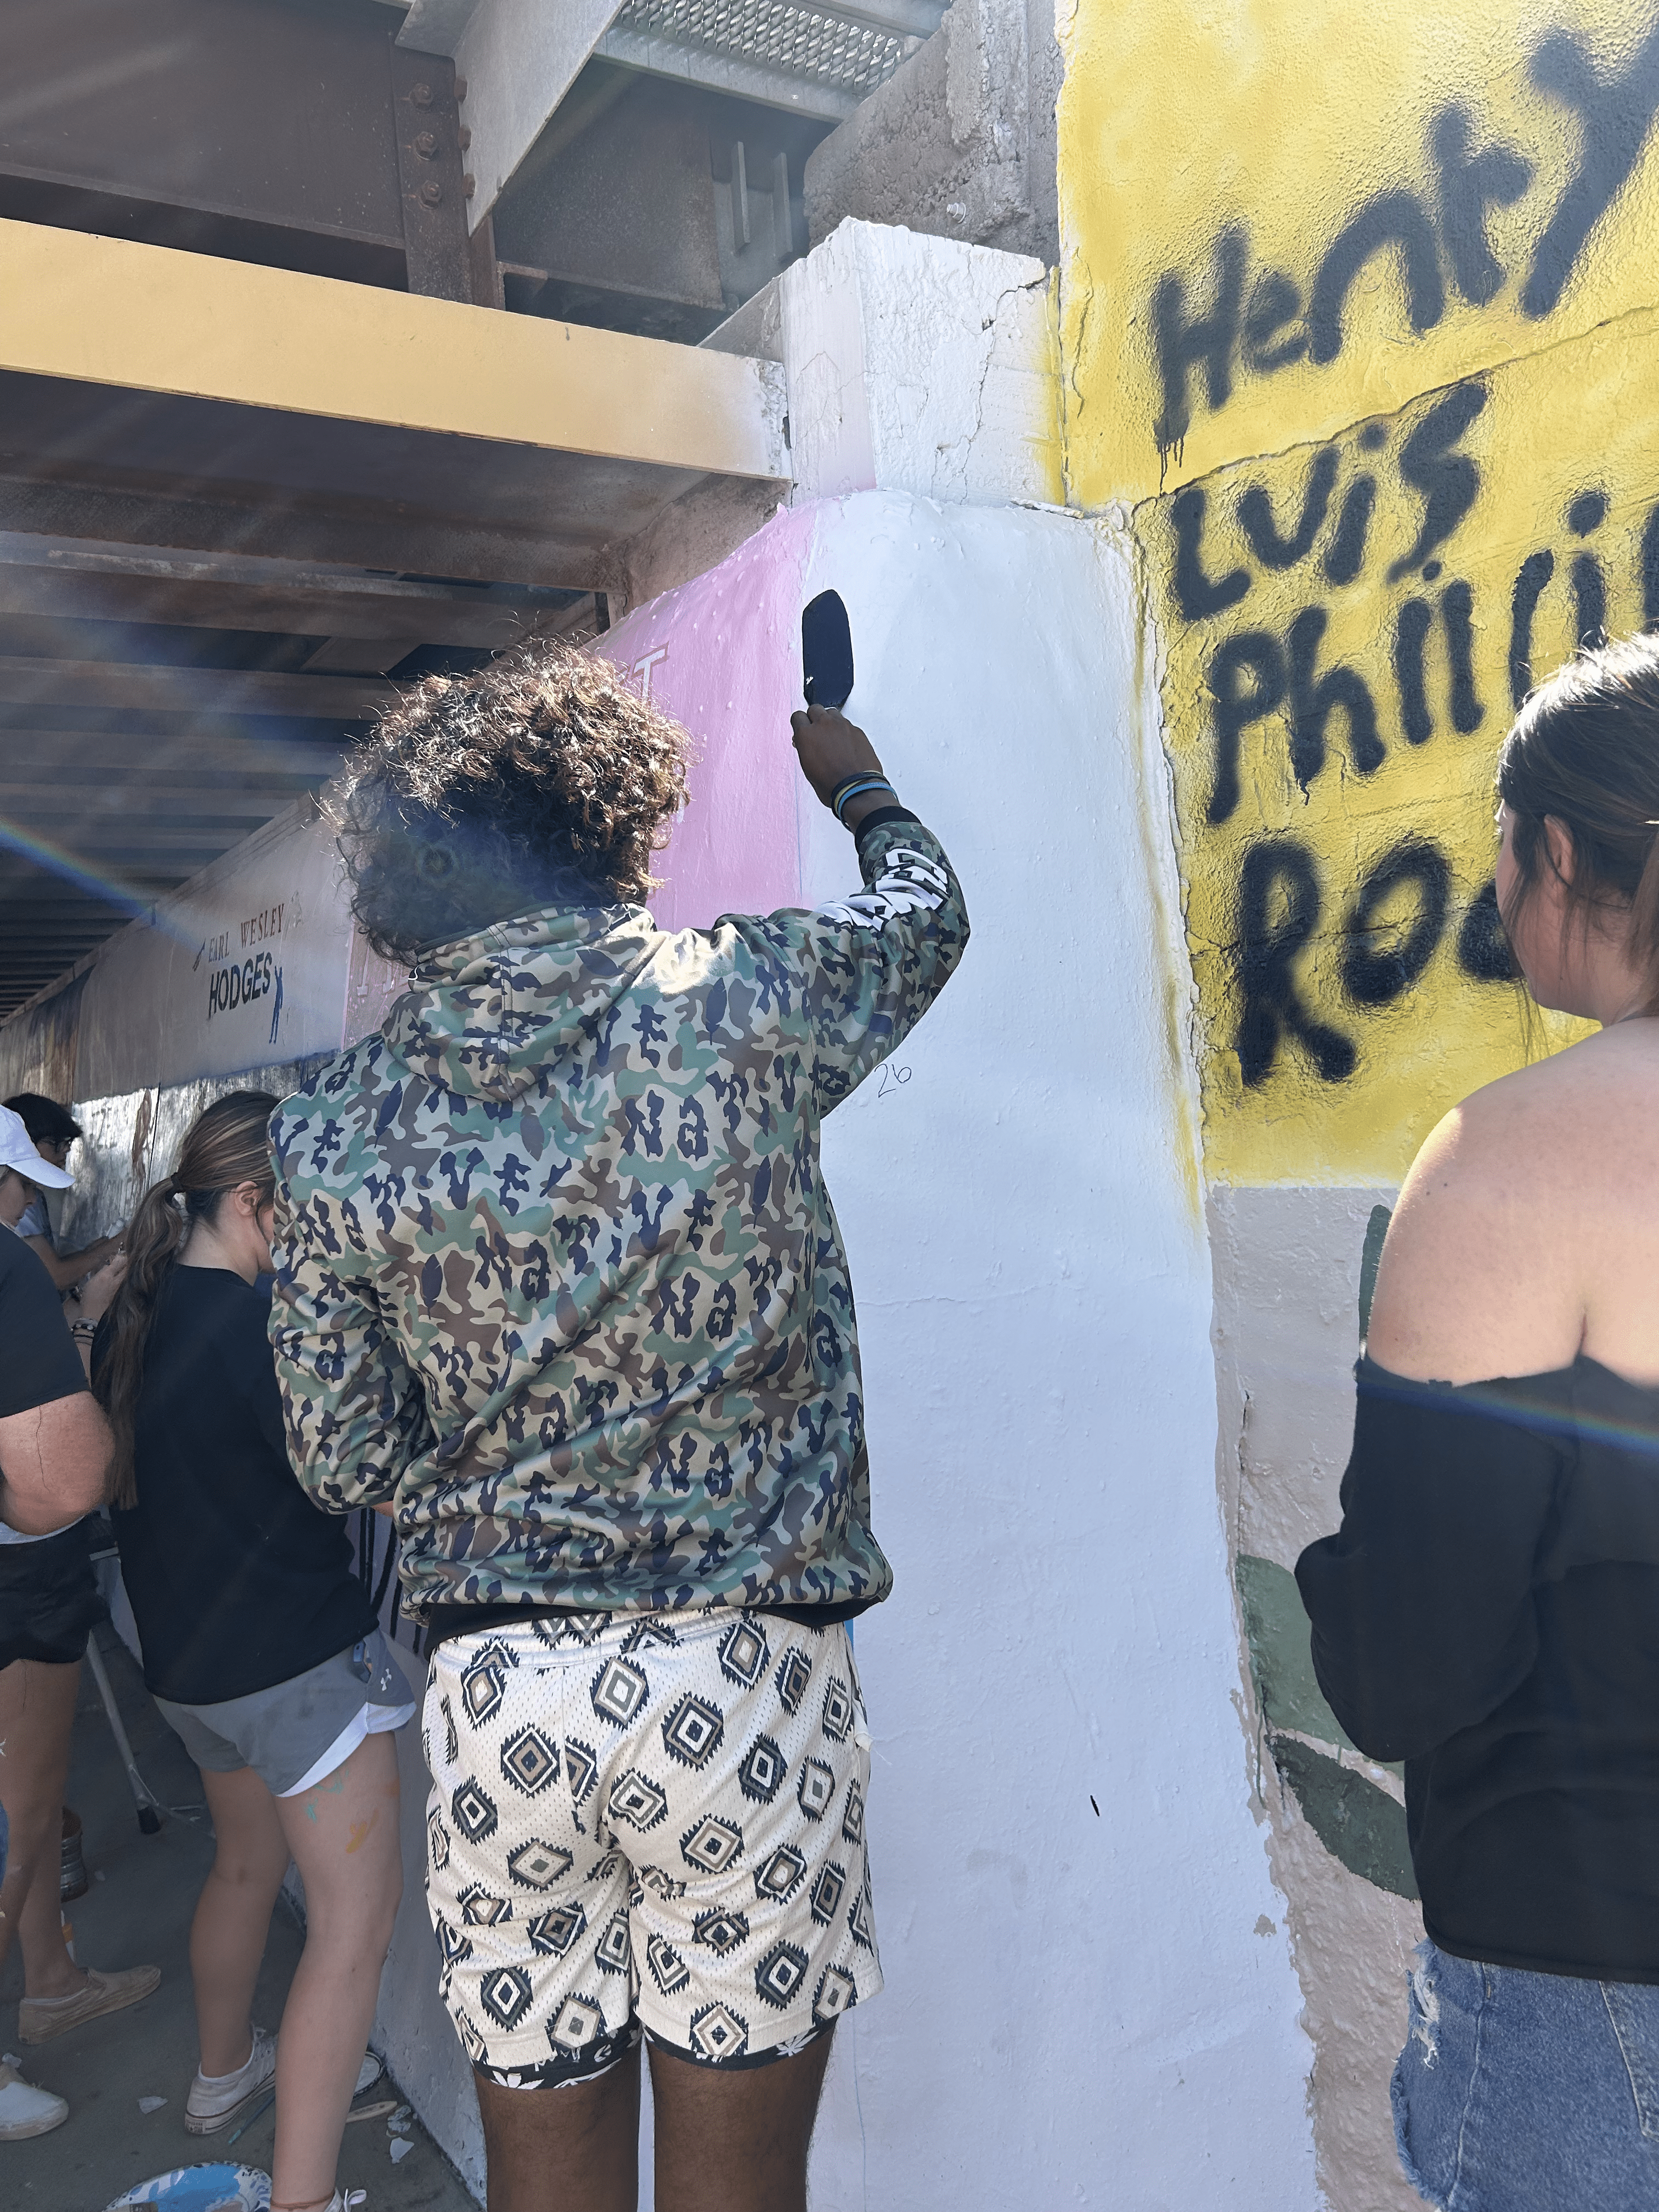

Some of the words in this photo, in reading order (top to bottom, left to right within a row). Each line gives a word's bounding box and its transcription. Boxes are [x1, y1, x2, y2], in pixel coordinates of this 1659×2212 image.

[1148, 25, 1659, 447] Henry
[1169, 381, 1488, 621] Luis
[1207, 490, 1659, 826] Philli
[207, 950, 273, 1020] HODGES
[208, 931, 229, 964] EARL
[241, 902, 285, 949] WESLEY
[873, 1063, 912, 1098] 26
